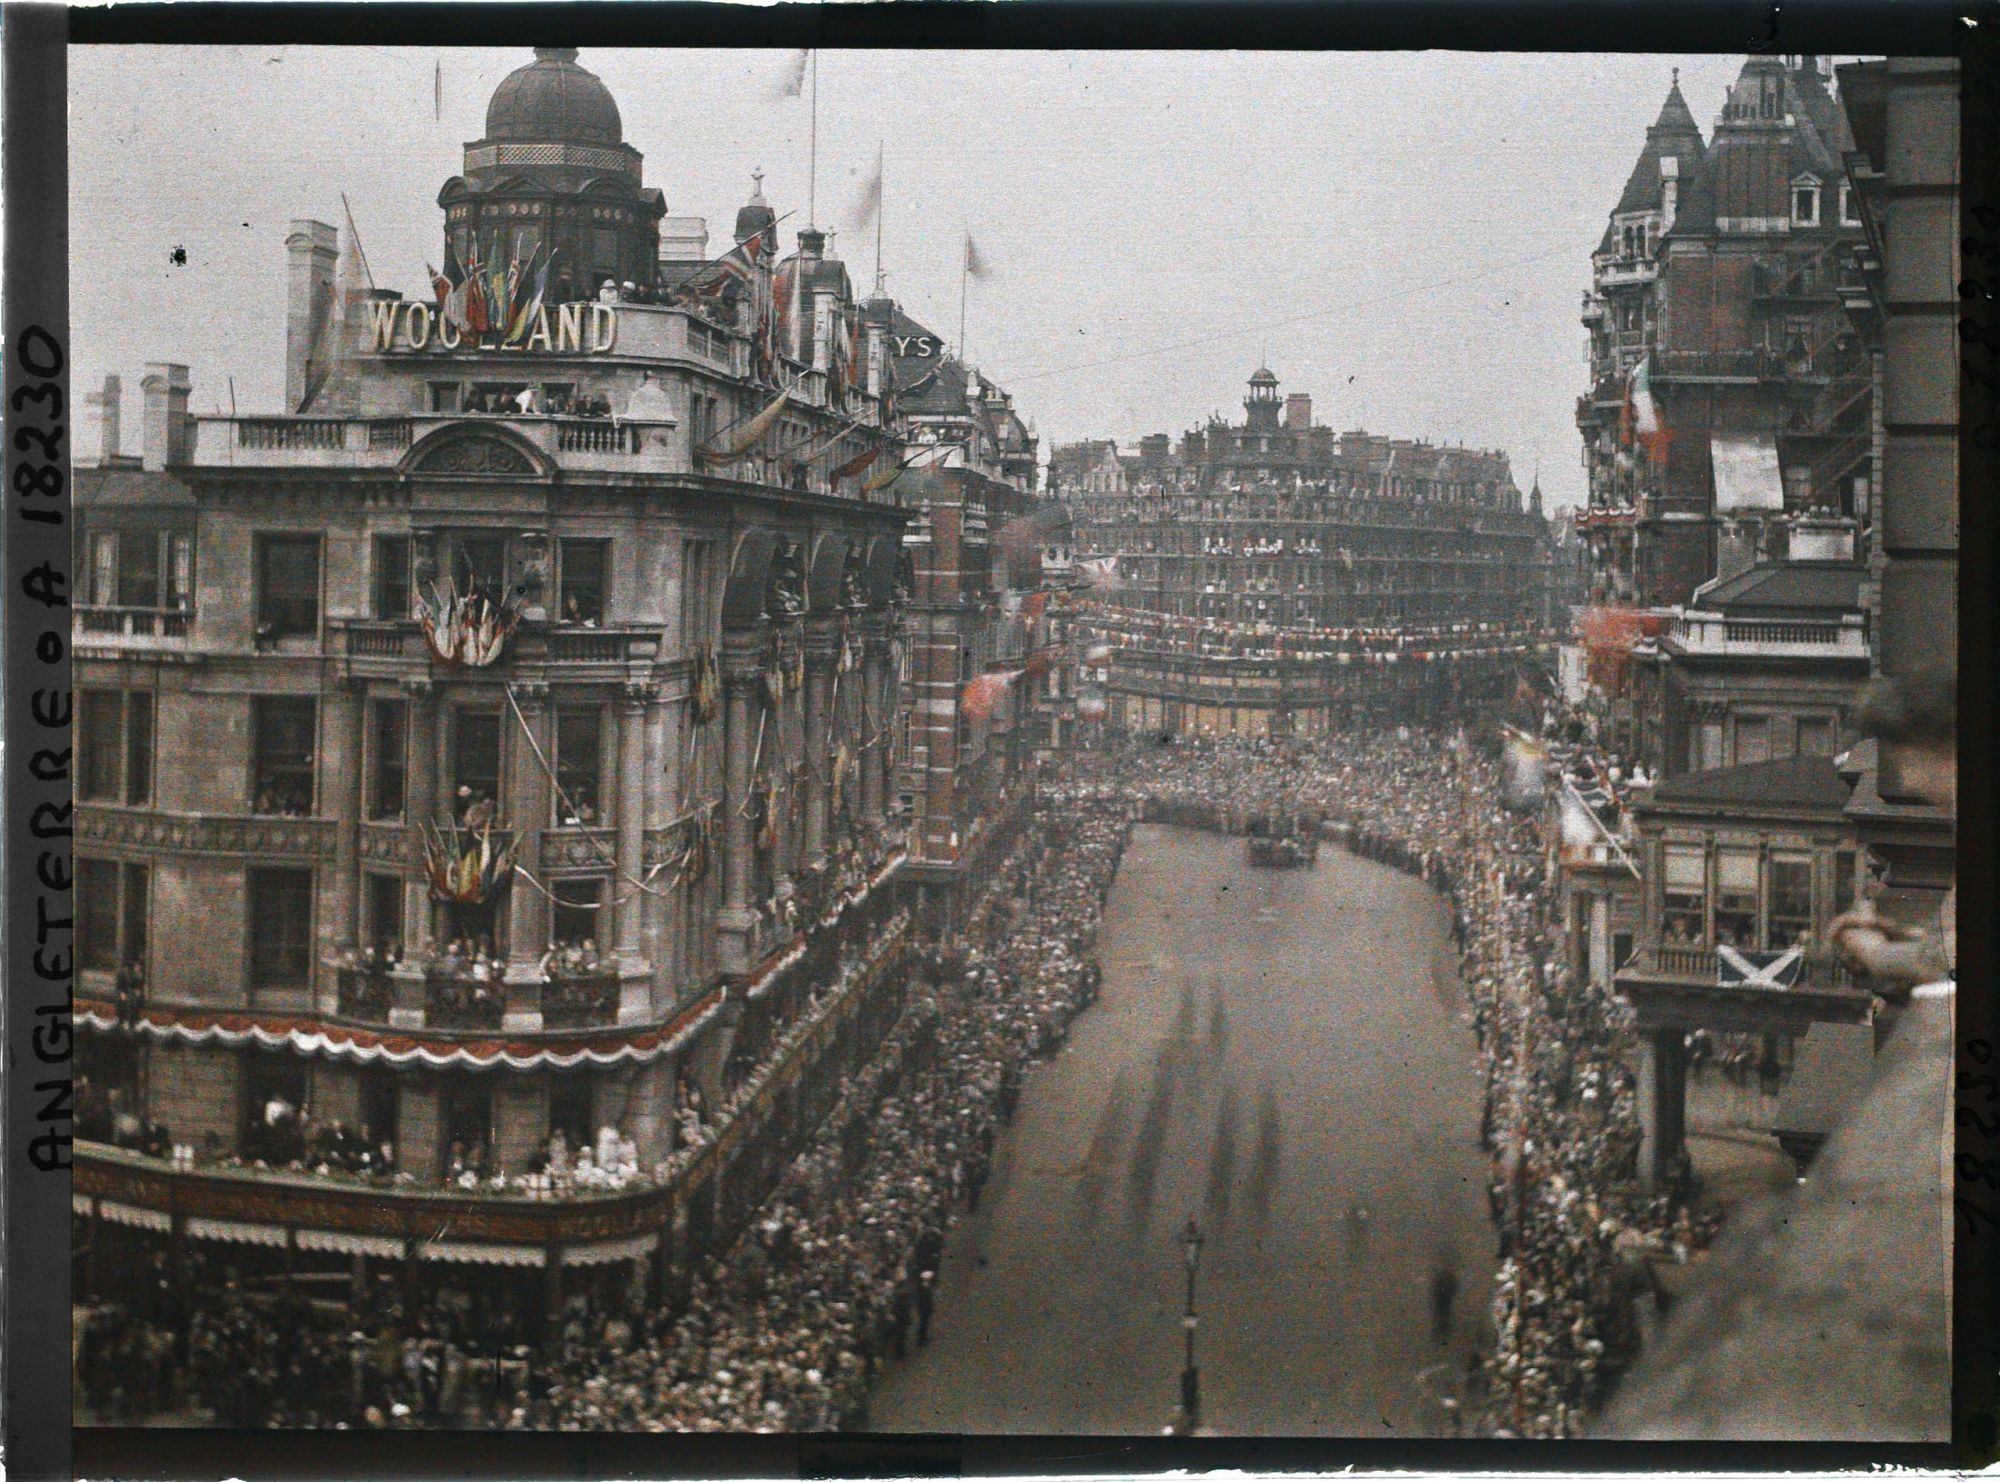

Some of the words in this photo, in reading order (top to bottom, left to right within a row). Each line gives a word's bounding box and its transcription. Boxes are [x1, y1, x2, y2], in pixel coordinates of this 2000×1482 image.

[12, 325, 64, 526] 18230
[21, 561, 68, 608] A
[25, 689, 75, 1173] ANGLETERRE
